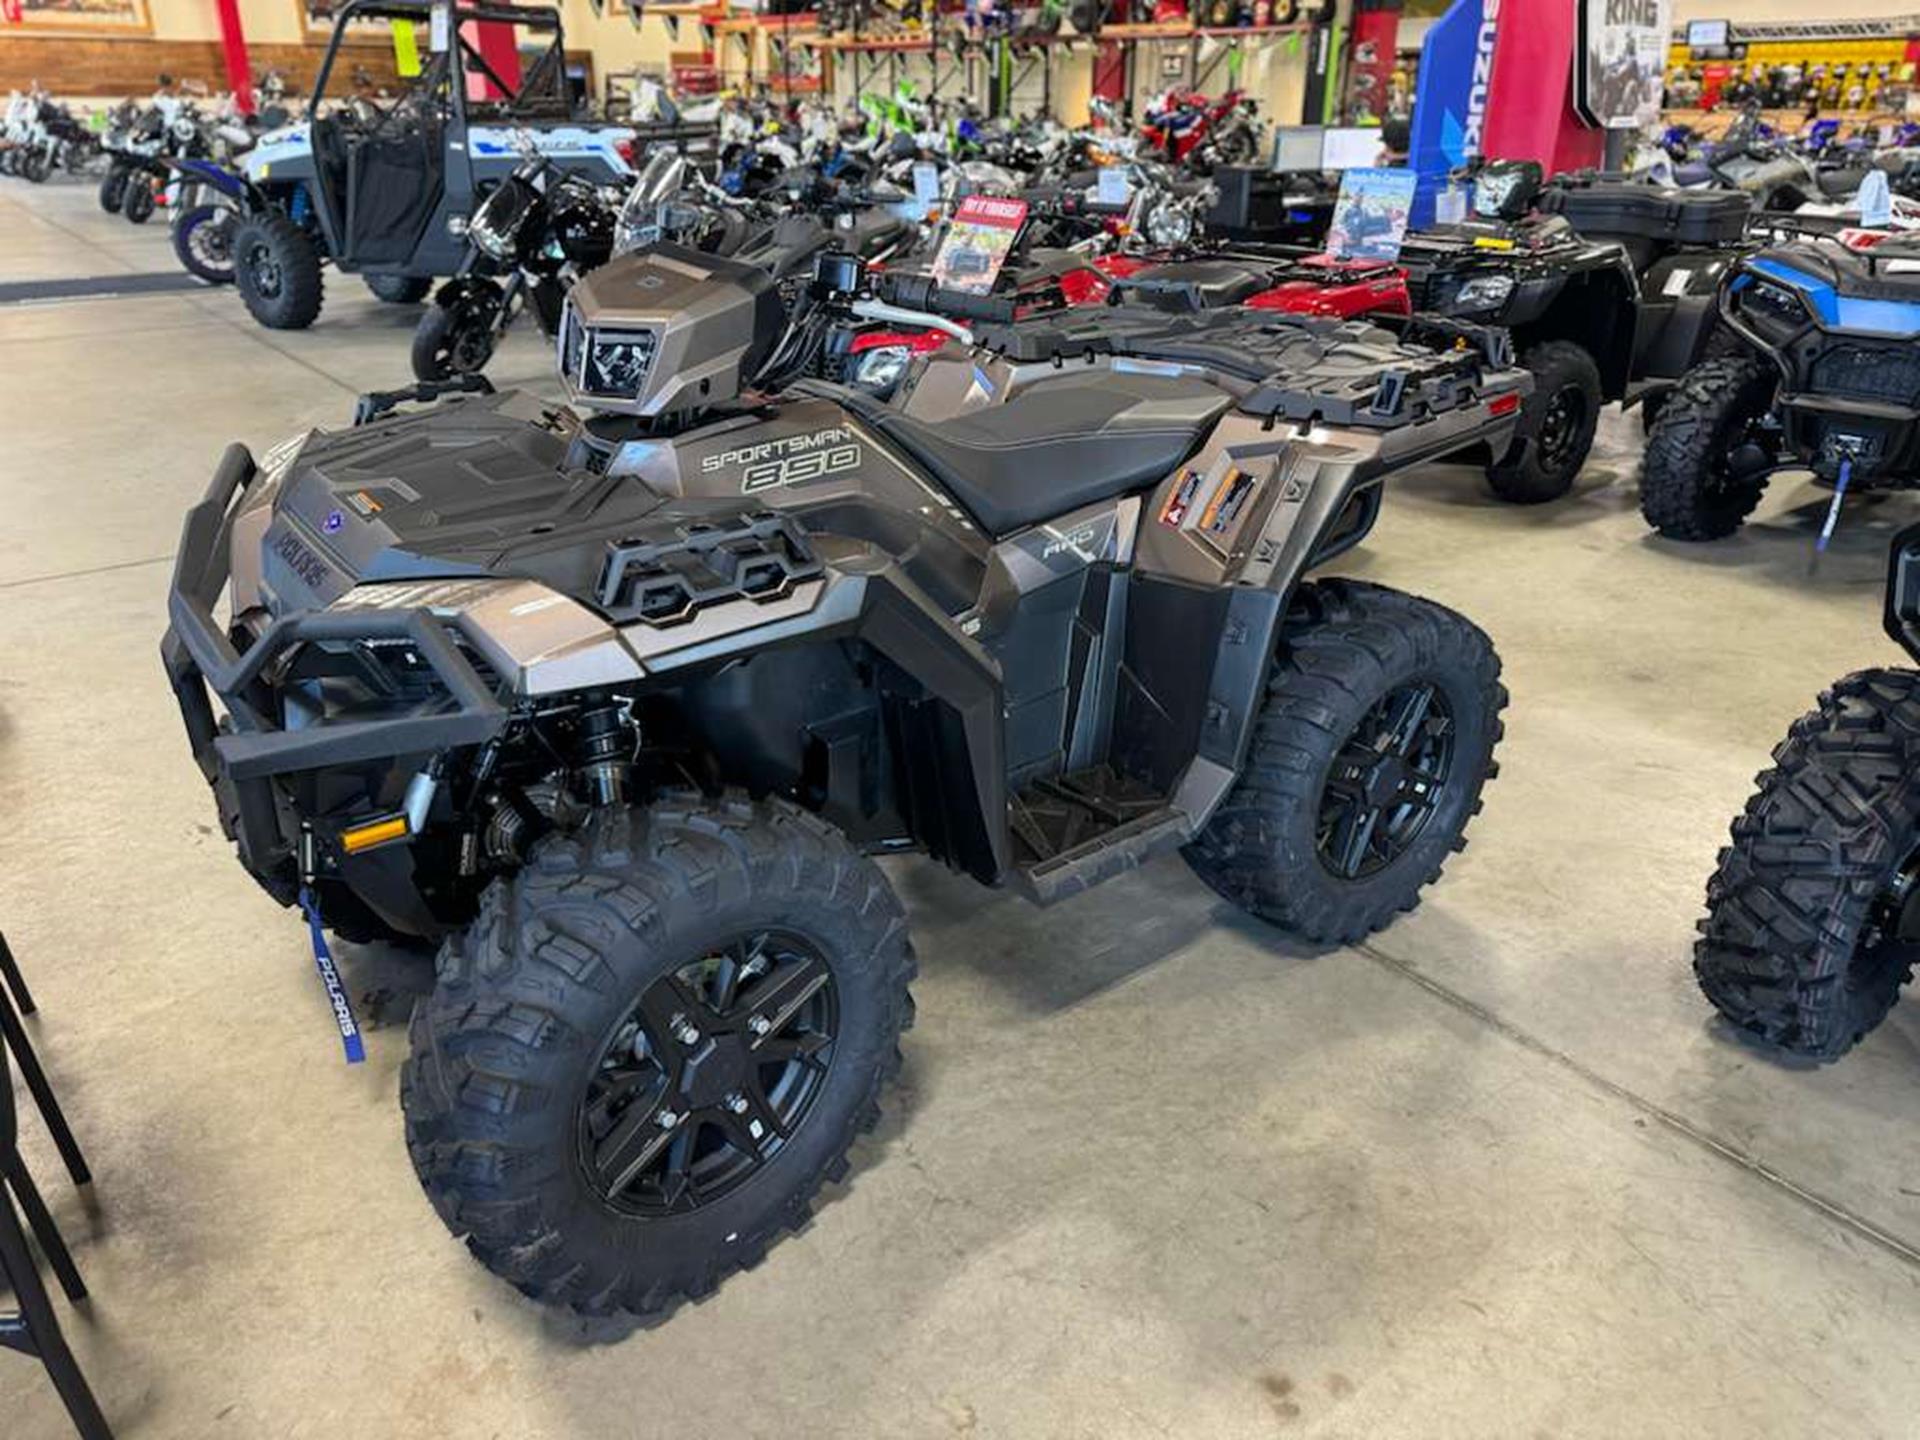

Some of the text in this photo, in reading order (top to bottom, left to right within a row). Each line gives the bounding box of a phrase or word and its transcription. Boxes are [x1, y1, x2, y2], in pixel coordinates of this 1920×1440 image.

[1605, 0, 1658, 27] KING
[1461, 0, 1501, 157] SUZUKI
[701, 428, 851, 473] SPORTSMAN
[740, 444, 862, 494] 850
[317, 957, 356, 1038] POLARIS
